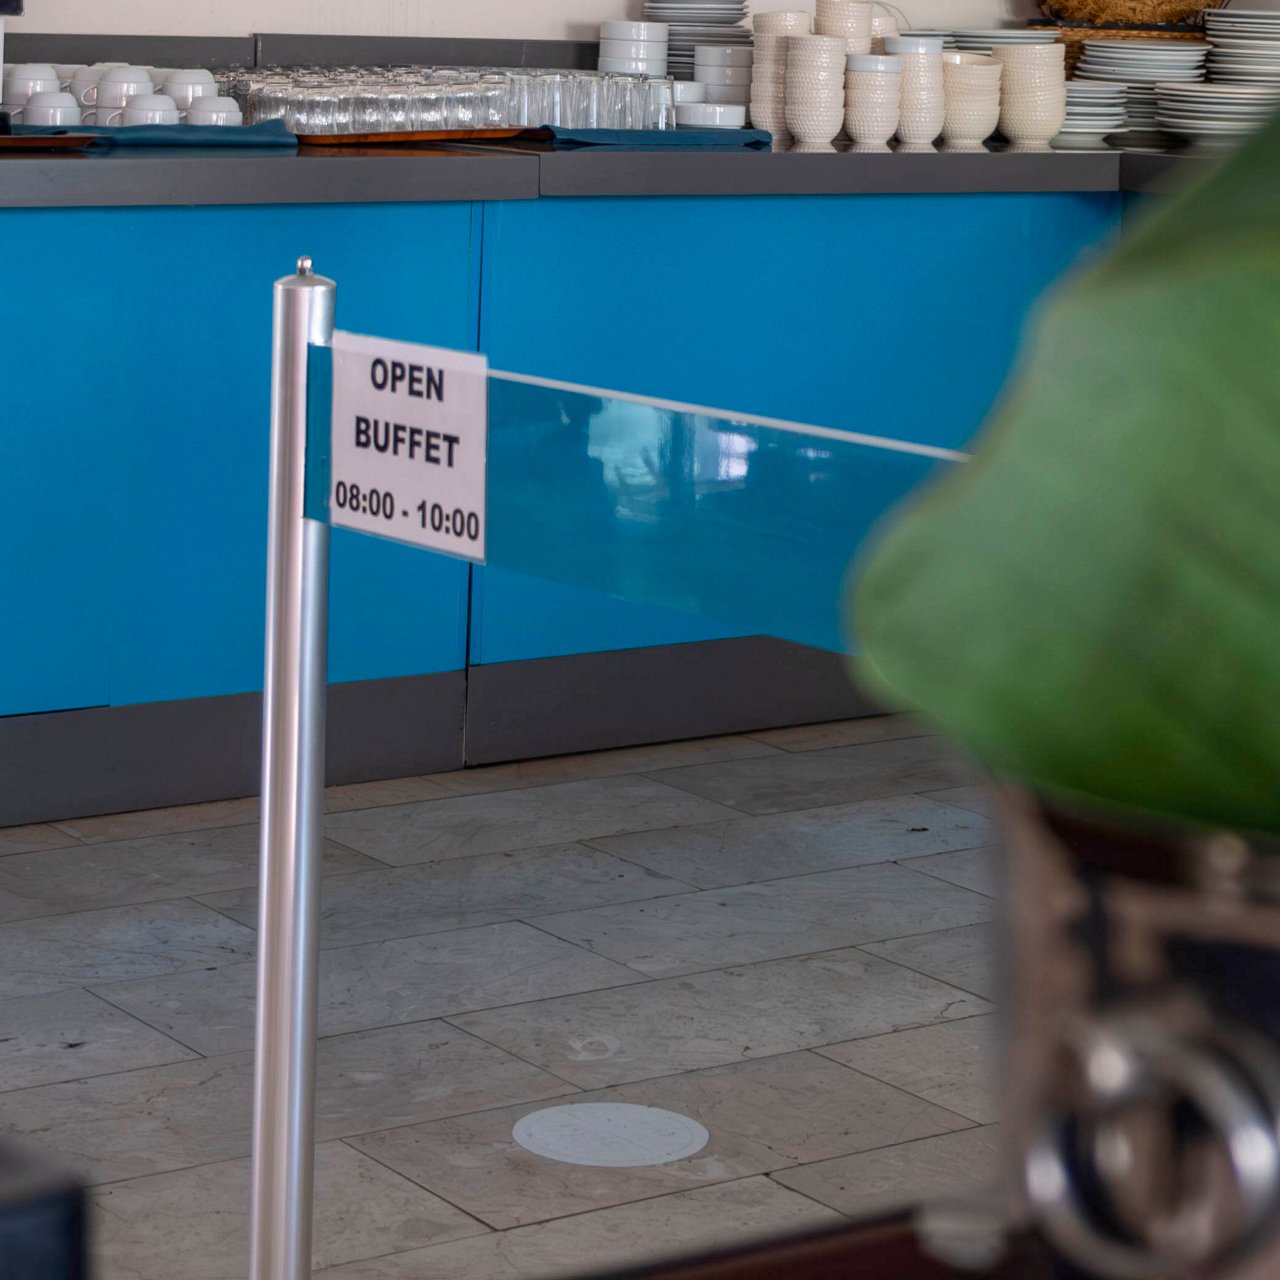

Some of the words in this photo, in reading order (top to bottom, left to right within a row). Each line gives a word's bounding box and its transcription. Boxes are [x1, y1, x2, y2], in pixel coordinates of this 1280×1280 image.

[370, 357, 444, 402] OPEN
[354, 415, 460, 468] BUFFET
[335, 480, 395, 520] 08:00
[417, 499, 480, 541] 10:00
